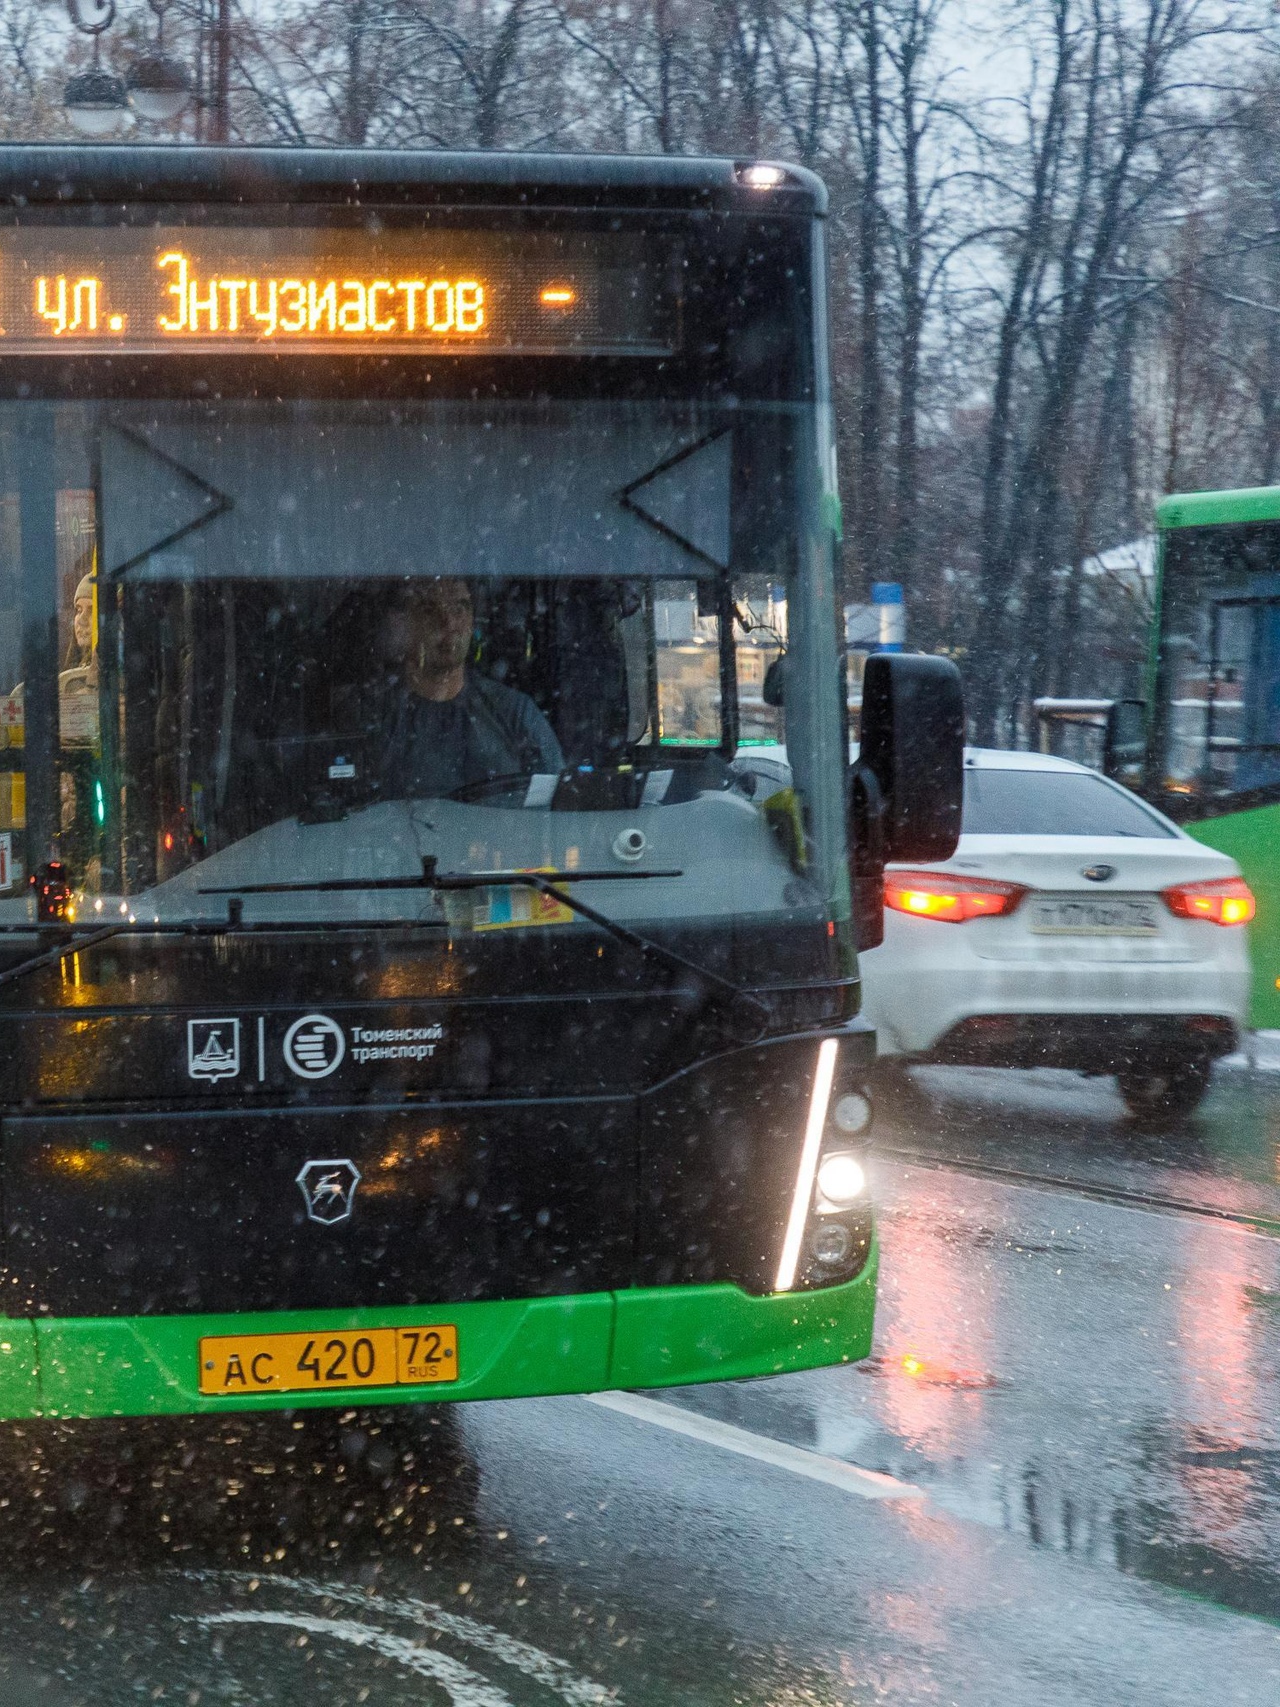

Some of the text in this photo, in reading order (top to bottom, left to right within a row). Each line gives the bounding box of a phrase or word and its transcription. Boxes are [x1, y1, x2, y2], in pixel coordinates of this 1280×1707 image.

[36, 276, 125, 336] ул.
[157, 250, 484, 337] Энтузиастов
[350, 1023, 443, 1043] Тюменский
[350, 1044, 437, 1065] транспорт
[296, 1337, 376, 1382] 420
[401, 1331, 442, 1365] 72
[407, 1364, 439, 1379] RUS
